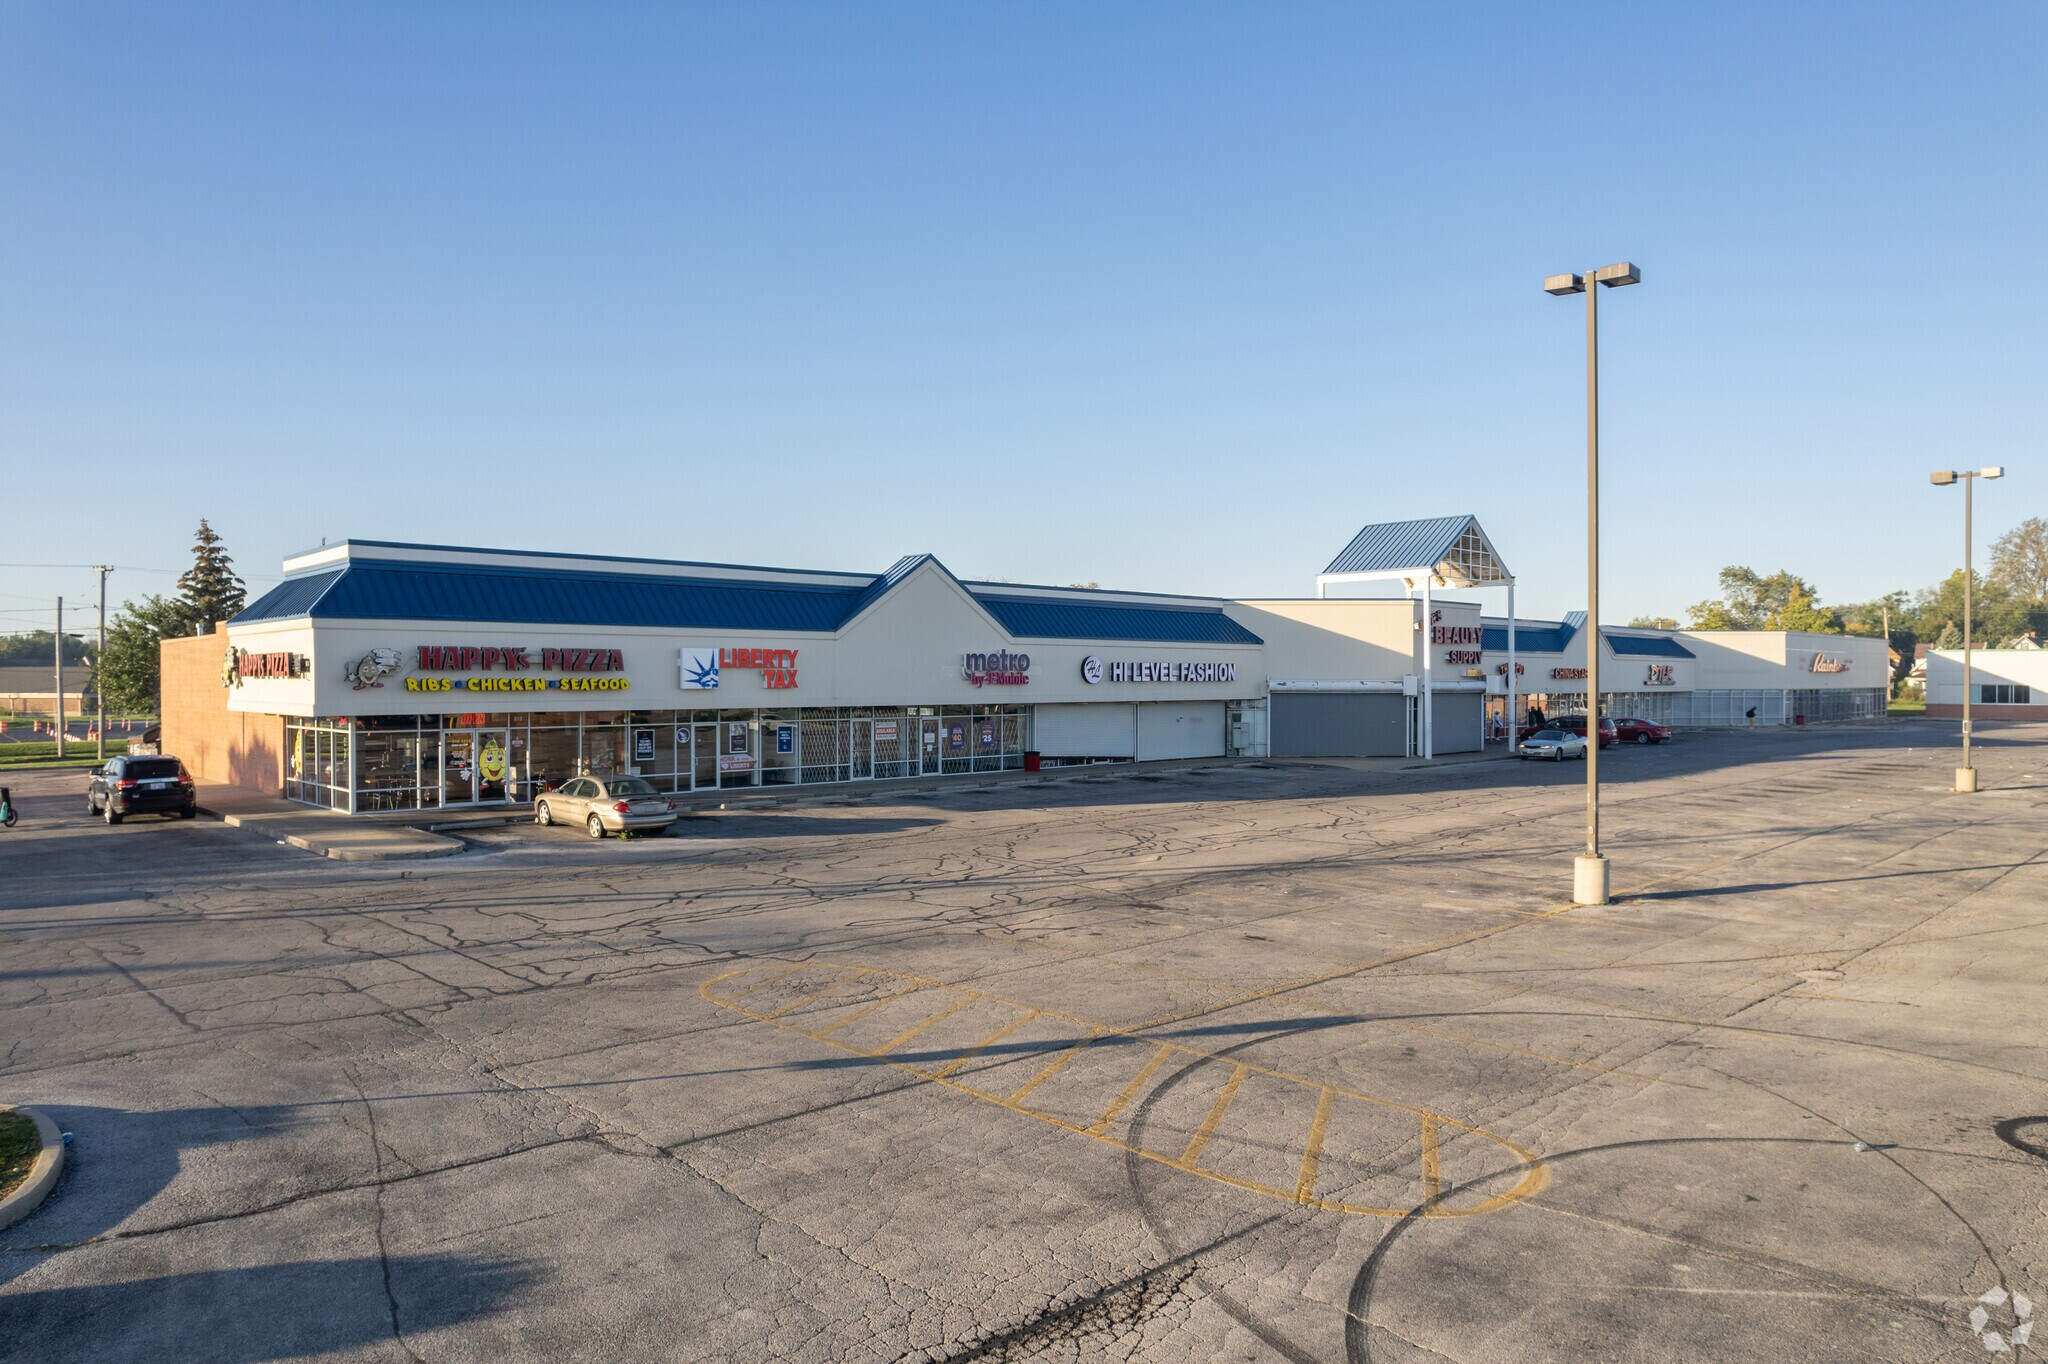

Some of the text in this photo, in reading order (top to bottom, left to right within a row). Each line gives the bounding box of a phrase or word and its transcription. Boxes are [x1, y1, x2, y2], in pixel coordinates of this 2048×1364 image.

[1434, 626, 1482, 644] BEAUTY
[266, 652, 289, 677] PIZZA
[542, 648, 624, 671] PIZZA
[719, 647, 799, 669] LIBERTY
[964, 649, 1031, 672] metro
[1449, 651, 1482, 665] SUPPLY
[762, 669, 799, 689] TAX
[971, 671, 985, 688] by
[1111, 662, 1237, 682] HI LEVEL FASHION
[406, 677, 630, 692] RIBS CHICKEN SEAFOOD
[461, 713, 486, 725] OPEN
